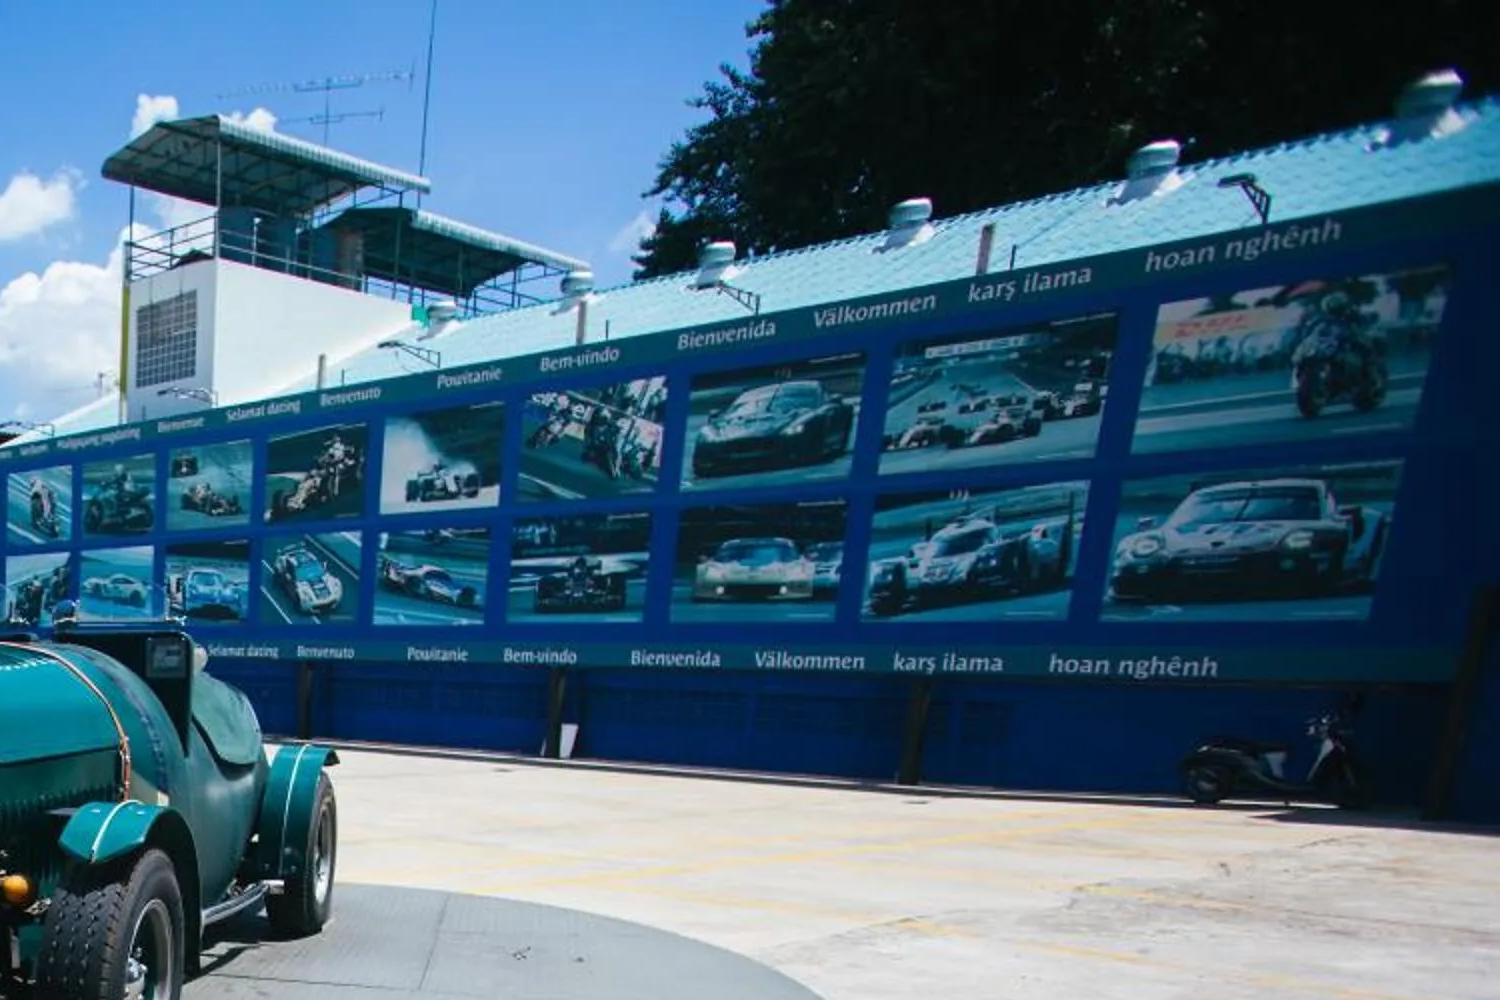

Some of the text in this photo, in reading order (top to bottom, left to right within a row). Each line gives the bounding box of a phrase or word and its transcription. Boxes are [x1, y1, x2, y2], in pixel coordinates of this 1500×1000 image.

[436, 217, 1342, 389] Powitanie Bem-vindo Bienvenida Välkommen karş ilama hoan nghênh
[319, 386, 382, 407] Benvenuto
[297, 645, 356, 659] Benvenuto
[406, 646, 469, 662] Powitanie
[503, 646, 577, 664] Bem-vindo
[630, 650, 722, 668] Bienvenida
[754, 651, 865, 670] Välkommen
[893, 652, 936, 675] karş
[942, 652, 1004, 672] ilama
[1049, 653, 1110, 674] hoan
[1117, 655, 1219, 679] nghênh
